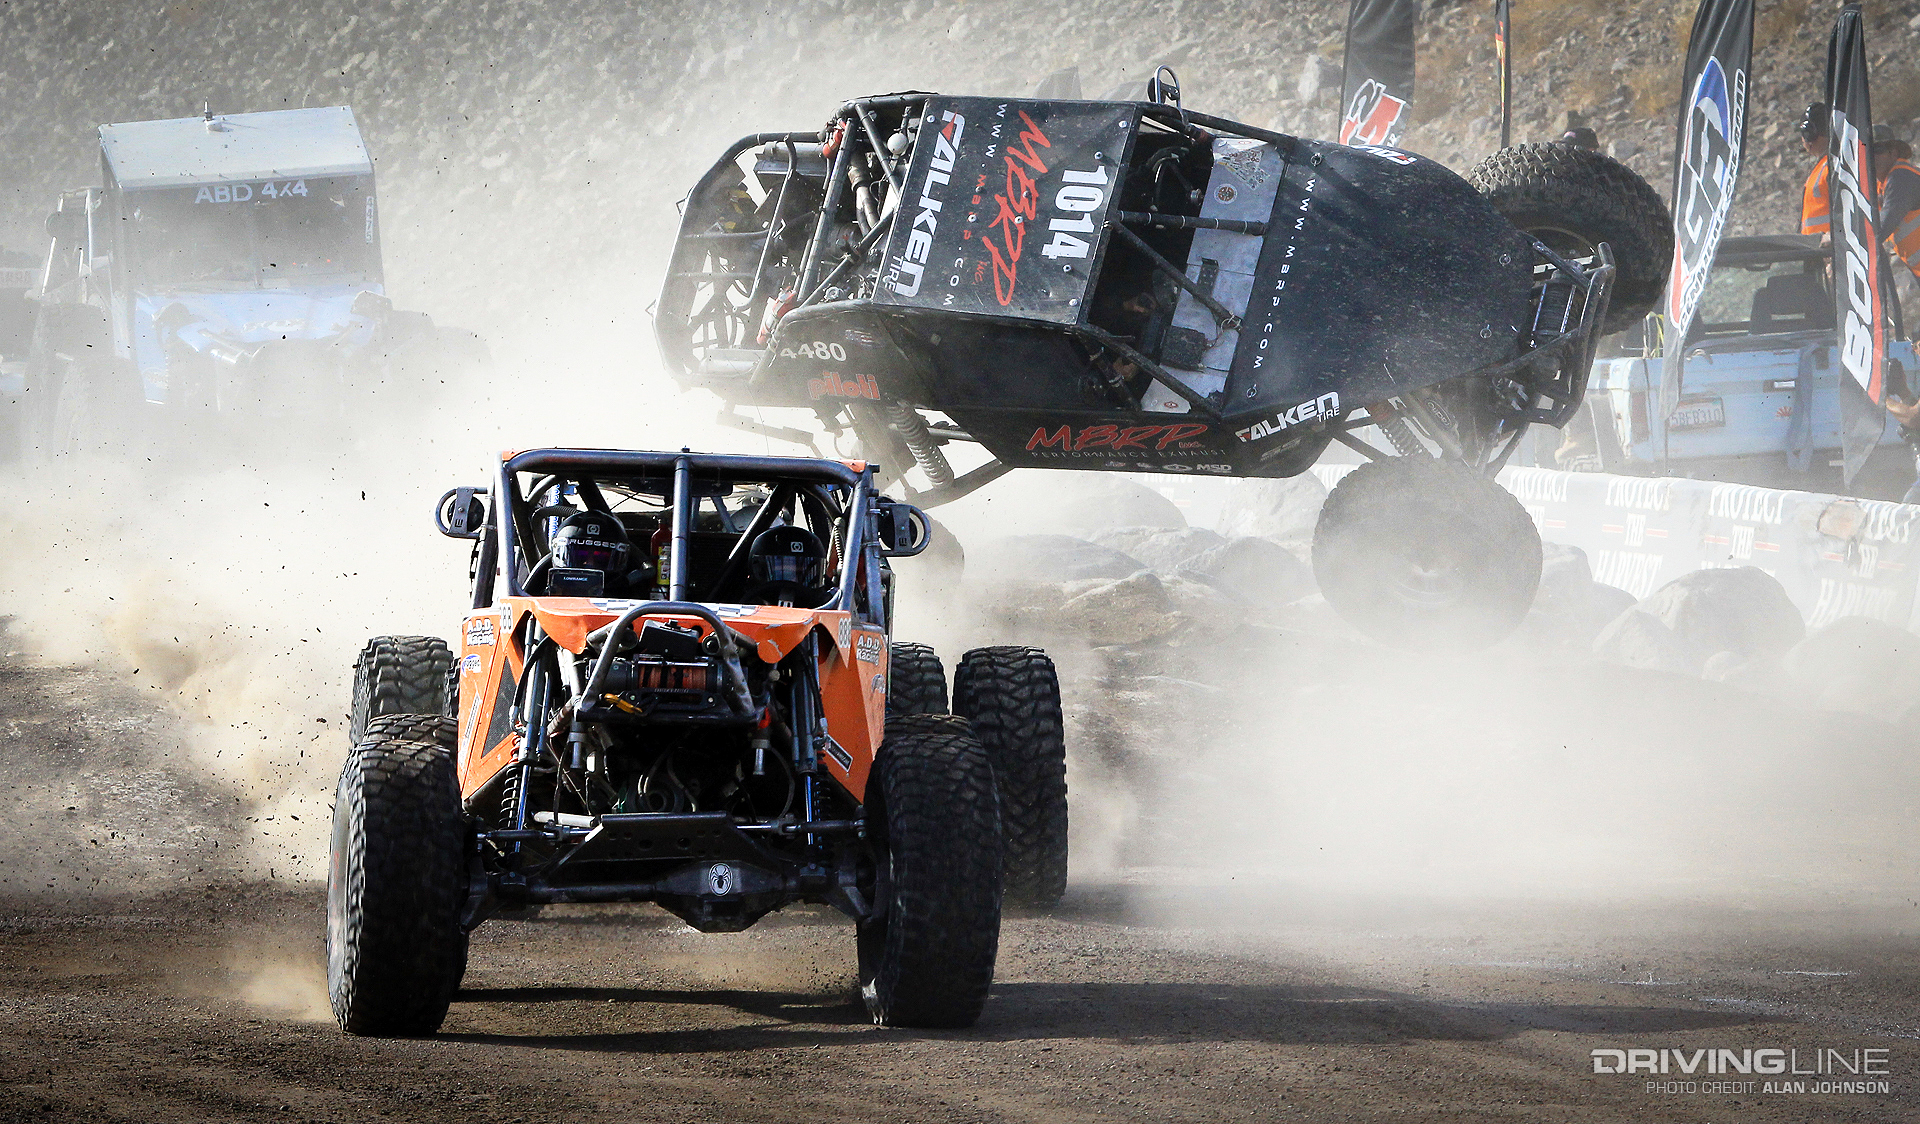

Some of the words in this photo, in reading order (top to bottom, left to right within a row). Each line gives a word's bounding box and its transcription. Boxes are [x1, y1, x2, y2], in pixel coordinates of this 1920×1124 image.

[194, 183, 253, 205] ABD
[895, 109, 966, 298] FALKEN
[983, 110, 1051, 306] MBRP
[1041, 165, 1110, 261] 1014
[884, 255, 905, 293] TIRE
[780, 341, 847, 362] 4480
[807, 372, 881, 401] piloti
[1235, 391, 1339, 443] FALKEN
[1316, 407, 1340, 423] TIRE
[1026, 424, 1208, 452] MBRP
[1031, 451, 1149, 459] PERFORMANCE
[1158, 449, 1227, 459] EXHAUST
[1196, 463, 1232, 471] MSD
[1605, 477, 1676, 511] PROTECT
[1709, 484, 1787, 524] PROTECT
[569, 539, 616, 549] RUGGED
